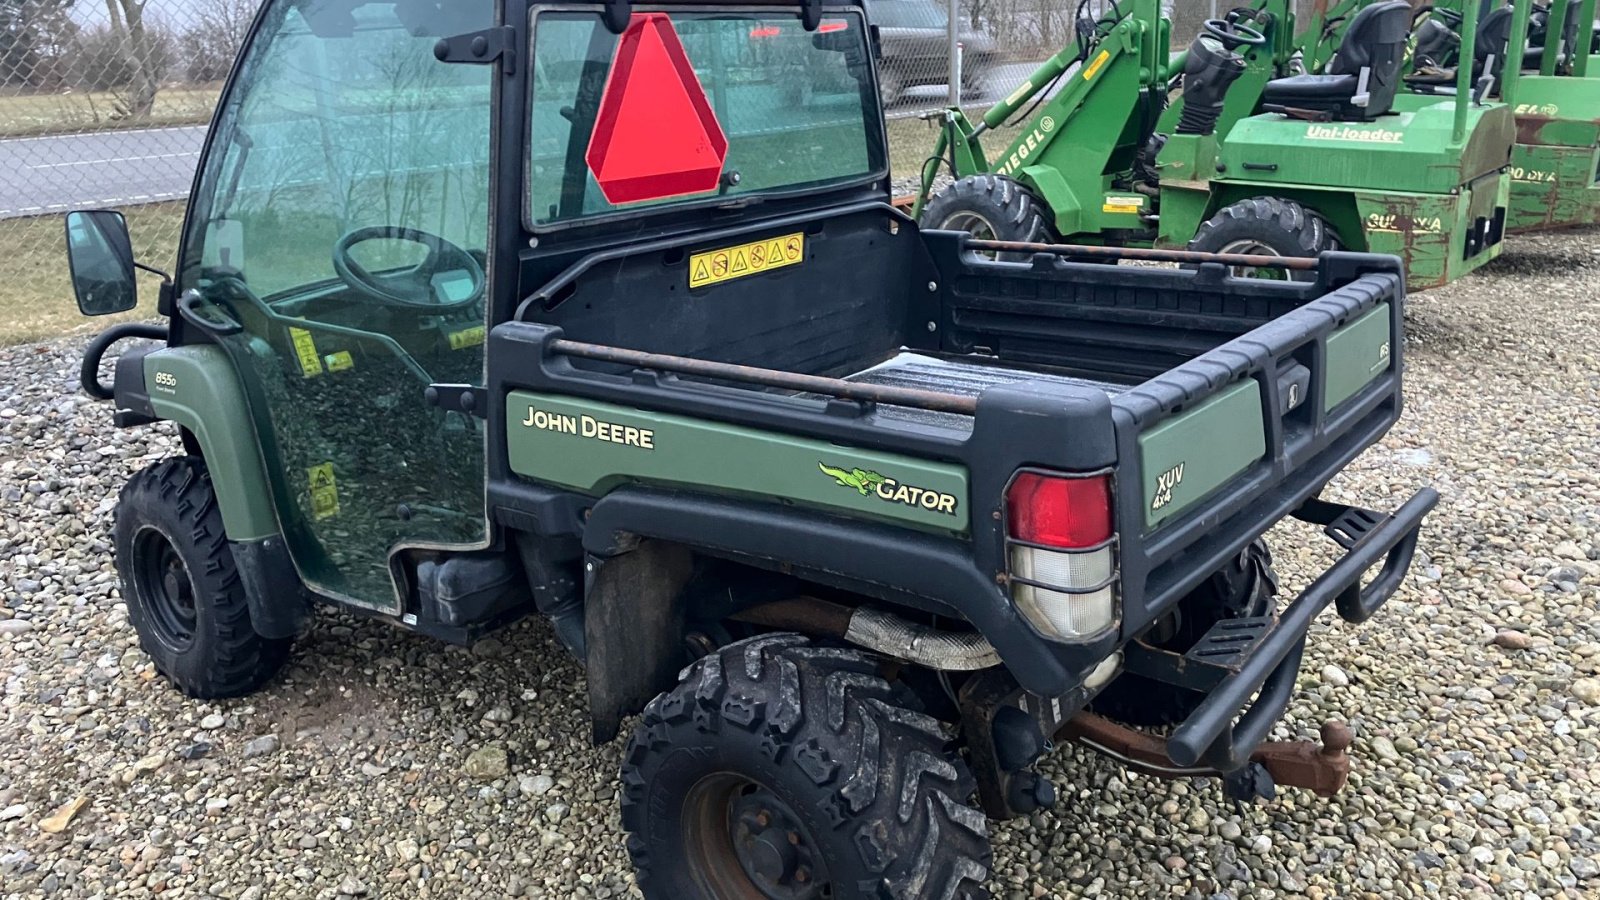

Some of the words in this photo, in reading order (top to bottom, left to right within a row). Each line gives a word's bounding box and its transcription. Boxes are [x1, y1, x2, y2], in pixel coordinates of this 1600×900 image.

[1305, 125, 1404, 142] Uni-loader
[522, 405, 578, 436] JOHN
[580, 414, 655, 450] DEERE
[1156, 461, 1185, 495] XUV
[876, 478, 958, 515] GATOR
